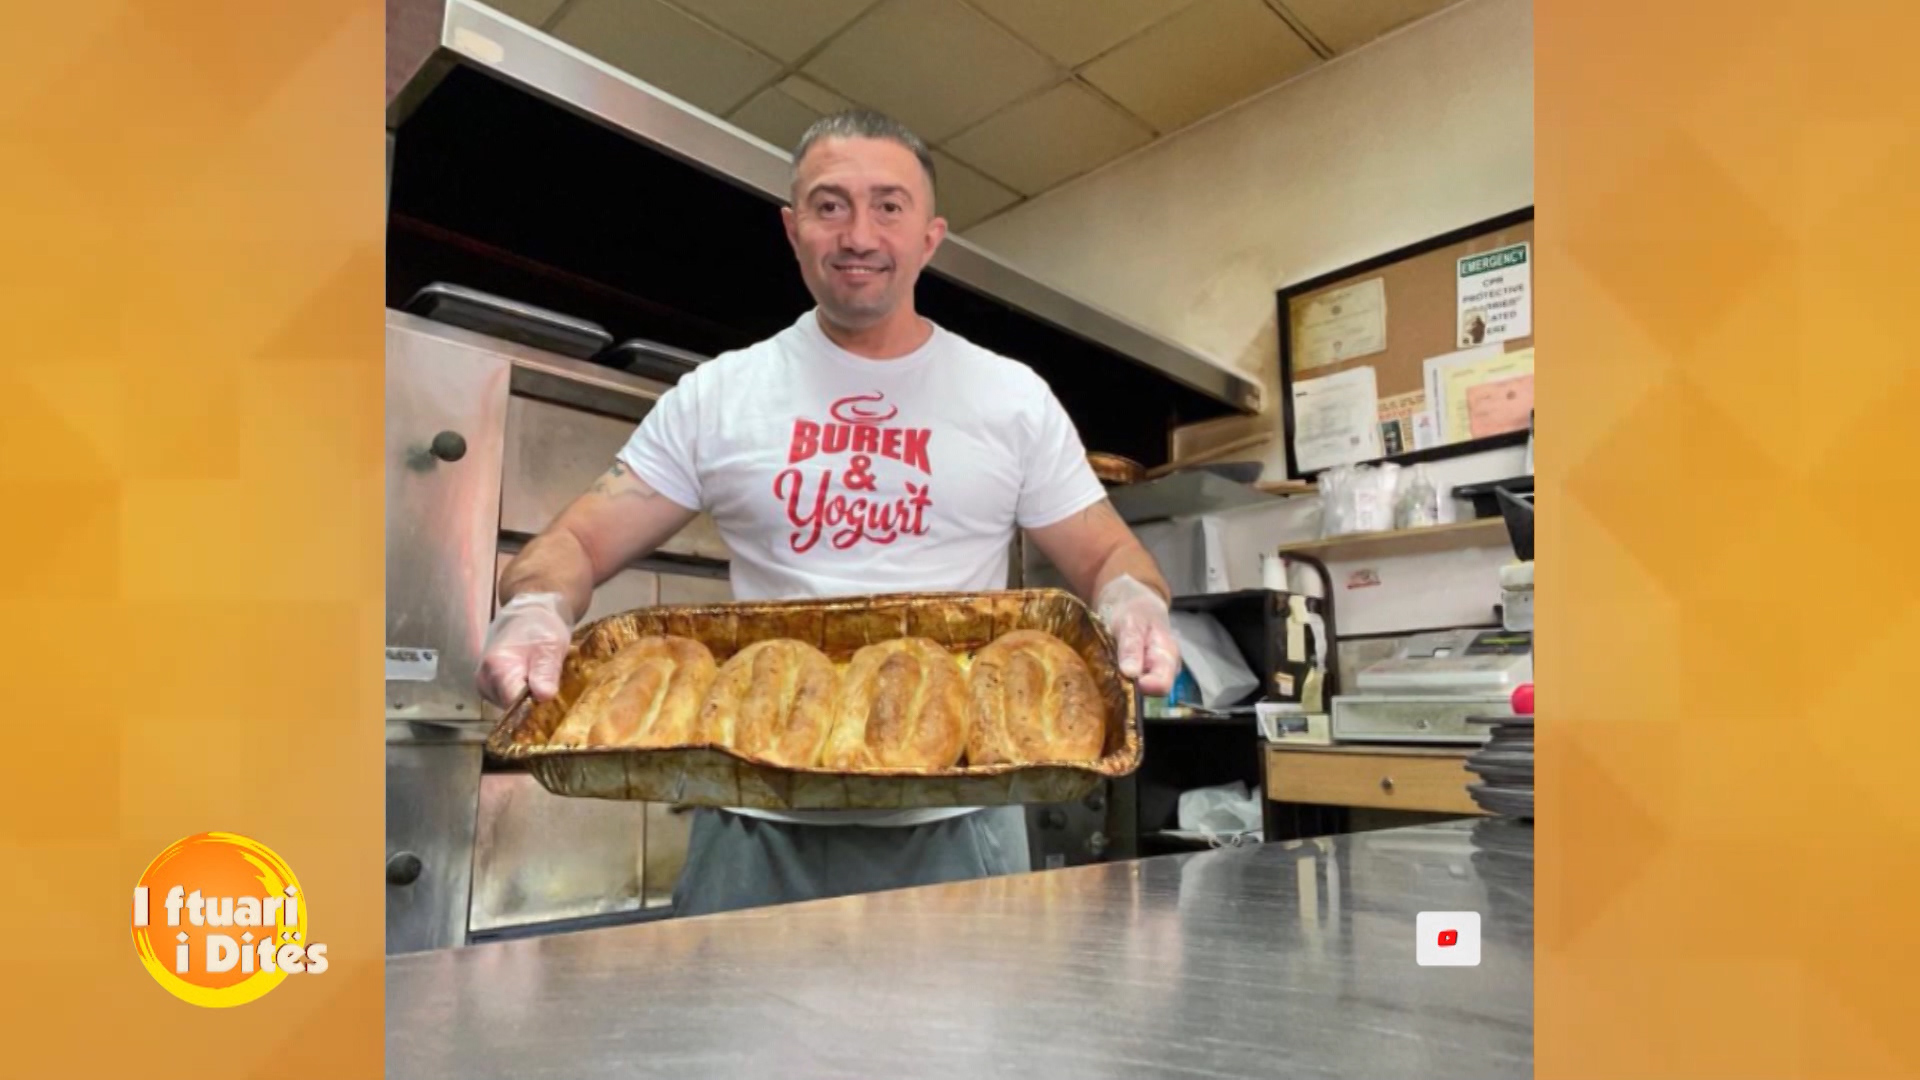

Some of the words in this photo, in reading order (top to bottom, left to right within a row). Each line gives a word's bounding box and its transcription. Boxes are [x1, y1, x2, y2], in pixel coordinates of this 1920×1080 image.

[1460, 248, 1524, 274] EMERGENCY
[788, 420, 932, 475] BUREK
[843, 455, 877, 491] &
[773, 469, 932, 554] Yogurt
